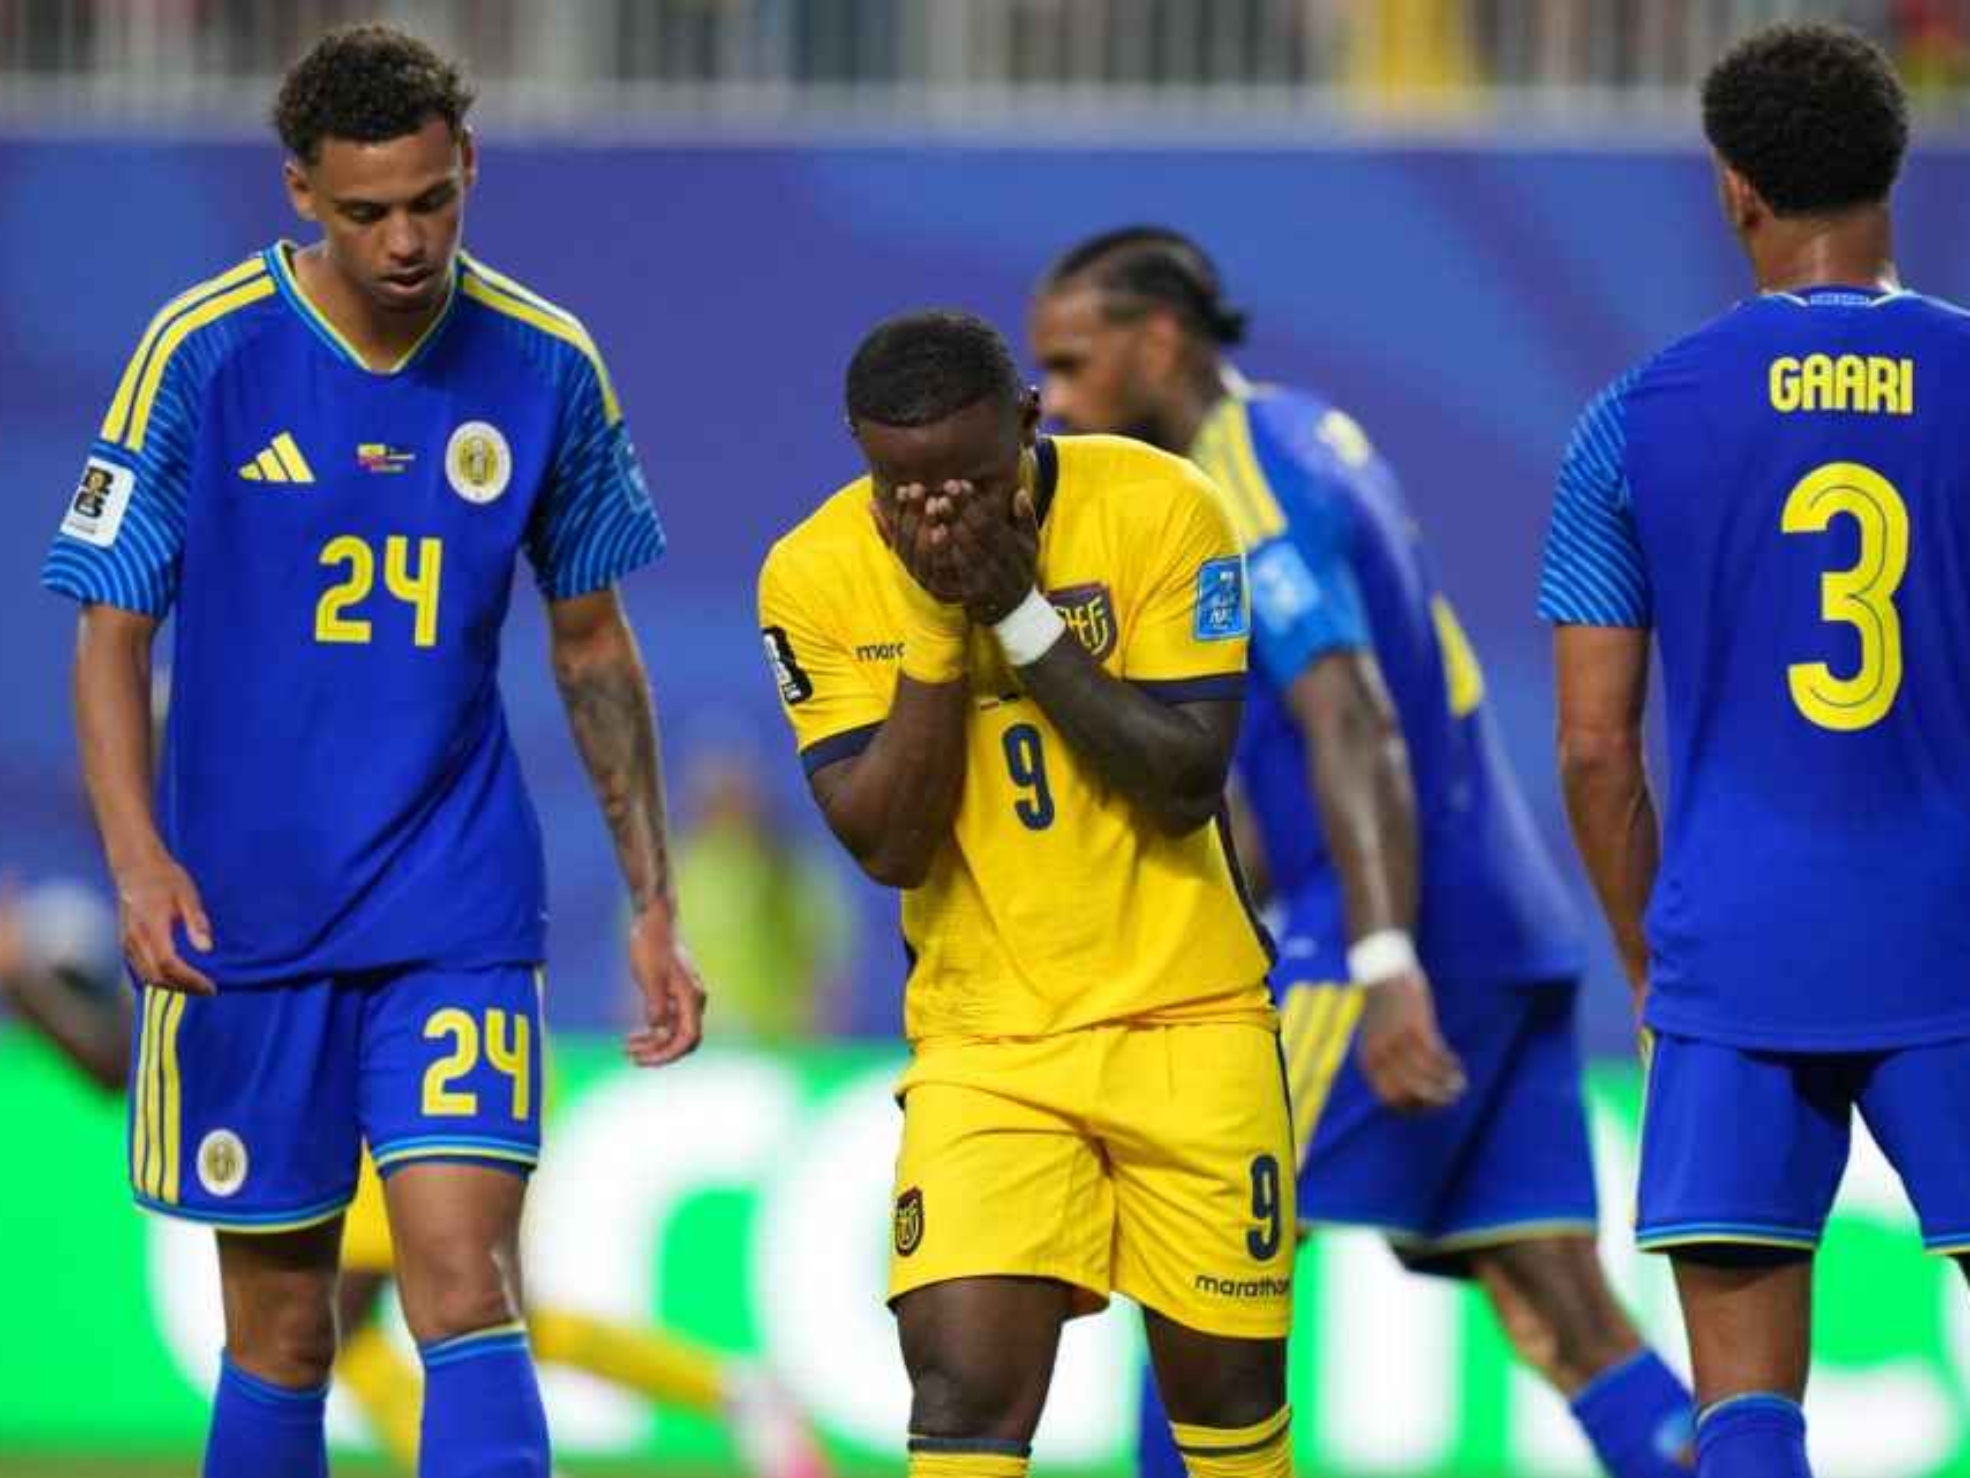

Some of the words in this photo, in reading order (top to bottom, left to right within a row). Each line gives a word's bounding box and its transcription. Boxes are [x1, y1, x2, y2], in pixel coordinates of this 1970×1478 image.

[1769, 353, 1915, 416] GAARI
[314, 534, 442, 648] 24
[1780, 461, 1910, 732] 3
[1001, 723, 1055, 832] 9
[421, 1007, 530, 1121] 24
[1246, 1154, 1282, 1262] 9
